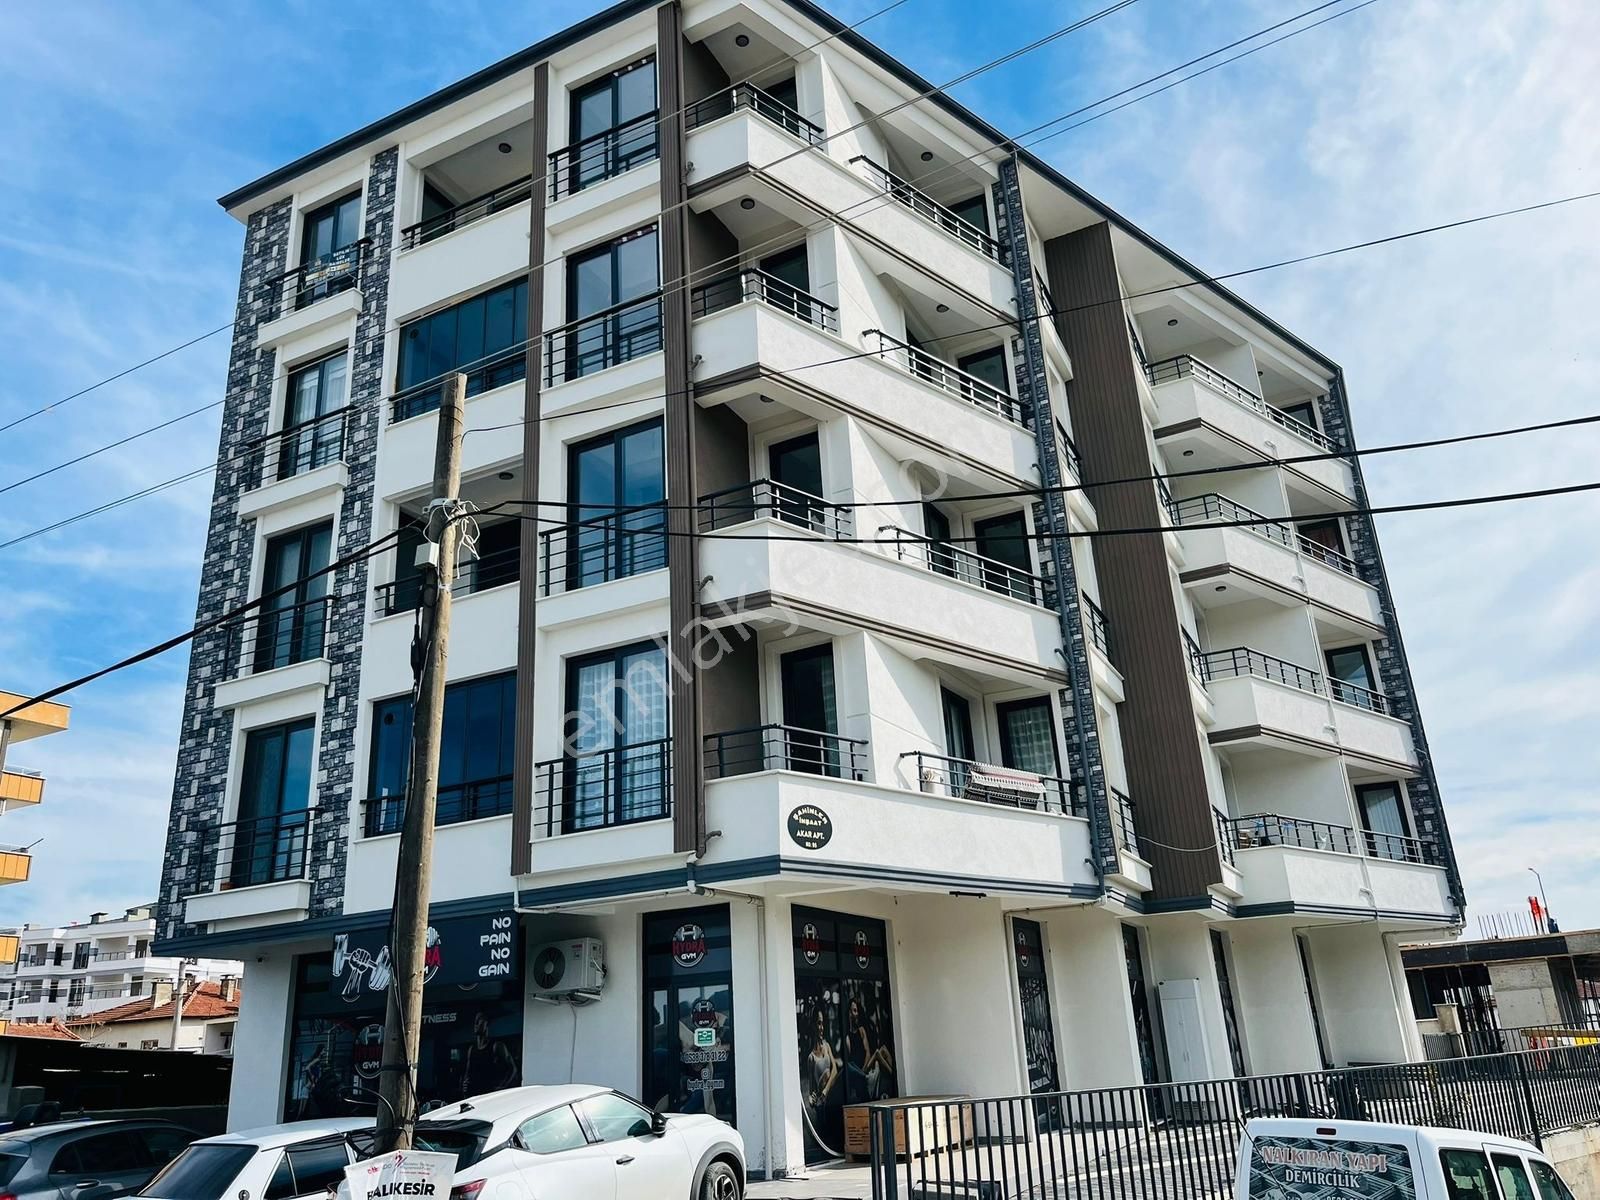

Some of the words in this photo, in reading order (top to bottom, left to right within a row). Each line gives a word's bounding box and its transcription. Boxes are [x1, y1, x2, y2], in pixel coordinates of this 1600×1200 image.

[492, 917, 512, 930] NO
[480, 933, 511, 947] PAIN
[490, 948, 511, 961] NO
[478, 963, 510, 977] GAIN
[422, 1011, 457, 1024] TNESS
[1262, 1146, 1344, 1169] NALKIRAN
[1346, 1152, 1388, 1173] YAPI
[1285, 1168, 1361, 1188] DEMİRCİLİK
